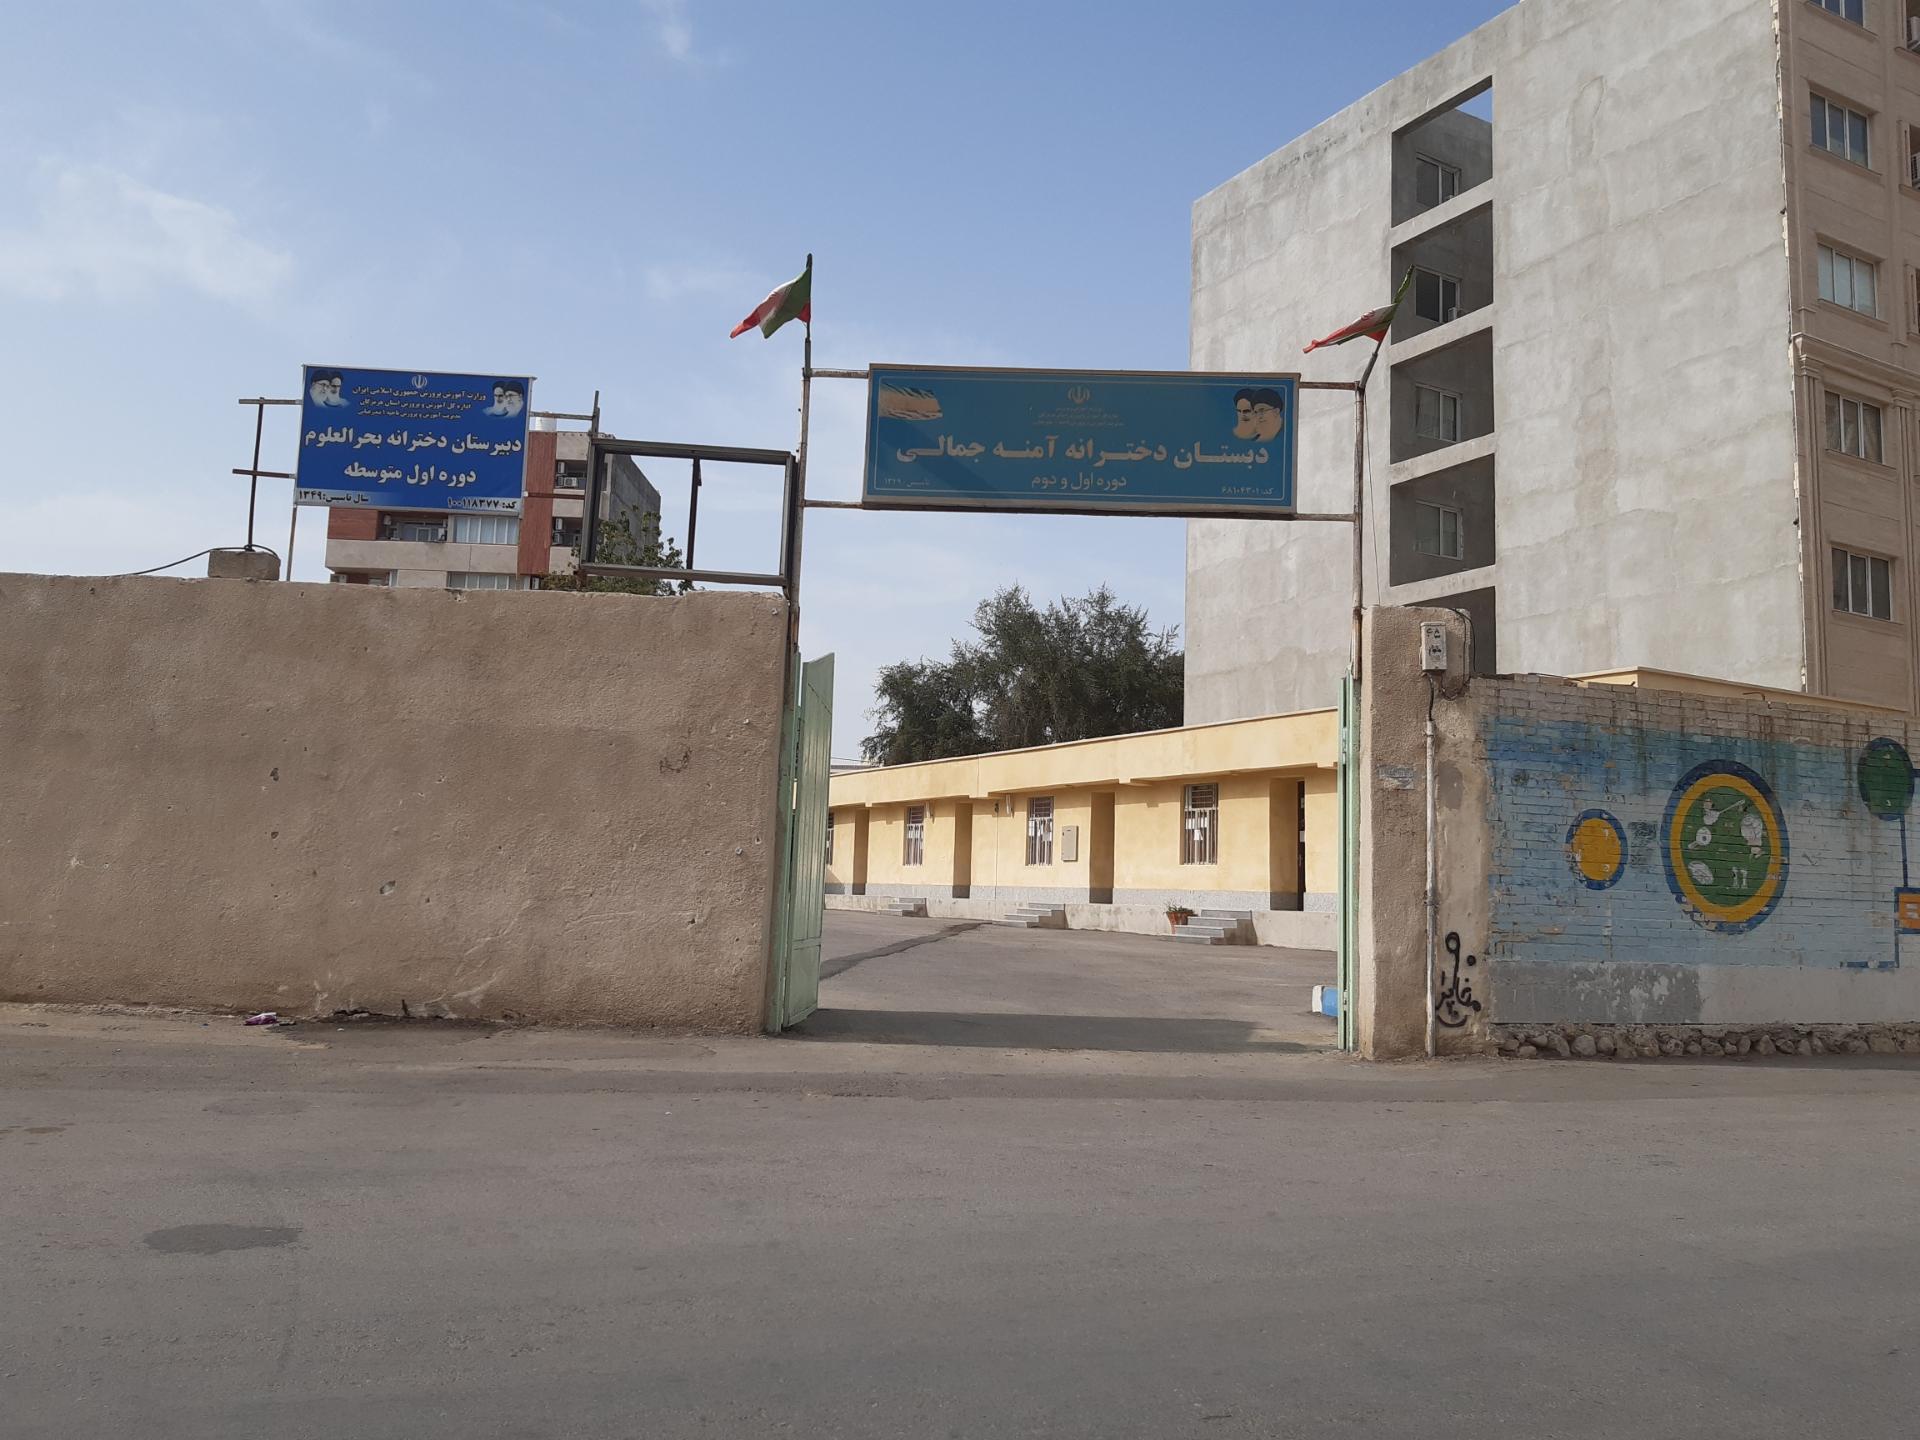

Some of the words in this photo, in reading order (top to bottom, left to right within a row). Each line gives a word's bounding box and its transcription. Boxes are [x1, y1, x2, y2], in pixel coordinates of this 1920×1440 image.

[352, 386, 369, 395] ایران
[370, 386, 392, 395] اسلامی
[392, 390, 418, 398] جمهوری
[442, 390, 466, 400] آموزش
[466, 391, 486, 401] وزارت
[305, 426, 382, 449] بحرالعلوم
[386, 430, 448, 452] دخترانه
[451, 433, 522, 456] دبیرستان
[896, 434, 986, 463] جمالی
[992, 435, 1059, 459] آمنه
[1065, 438, 1168, 467] دخترانه
[1173, 441, 1270, 469] دبستان
[344, 461, 402, 484] متوسطه
[406, 463, 435, 485] اول
[438, 470, 477, 487] دوره
[1031, 474, 1056, 489] دوم
[1070, 471, 1094, 490] اول
[1060, 477, 1068, 490] و
[1096, 475, 1127, 491] دوره
[353, 493, 369, 504] سال
